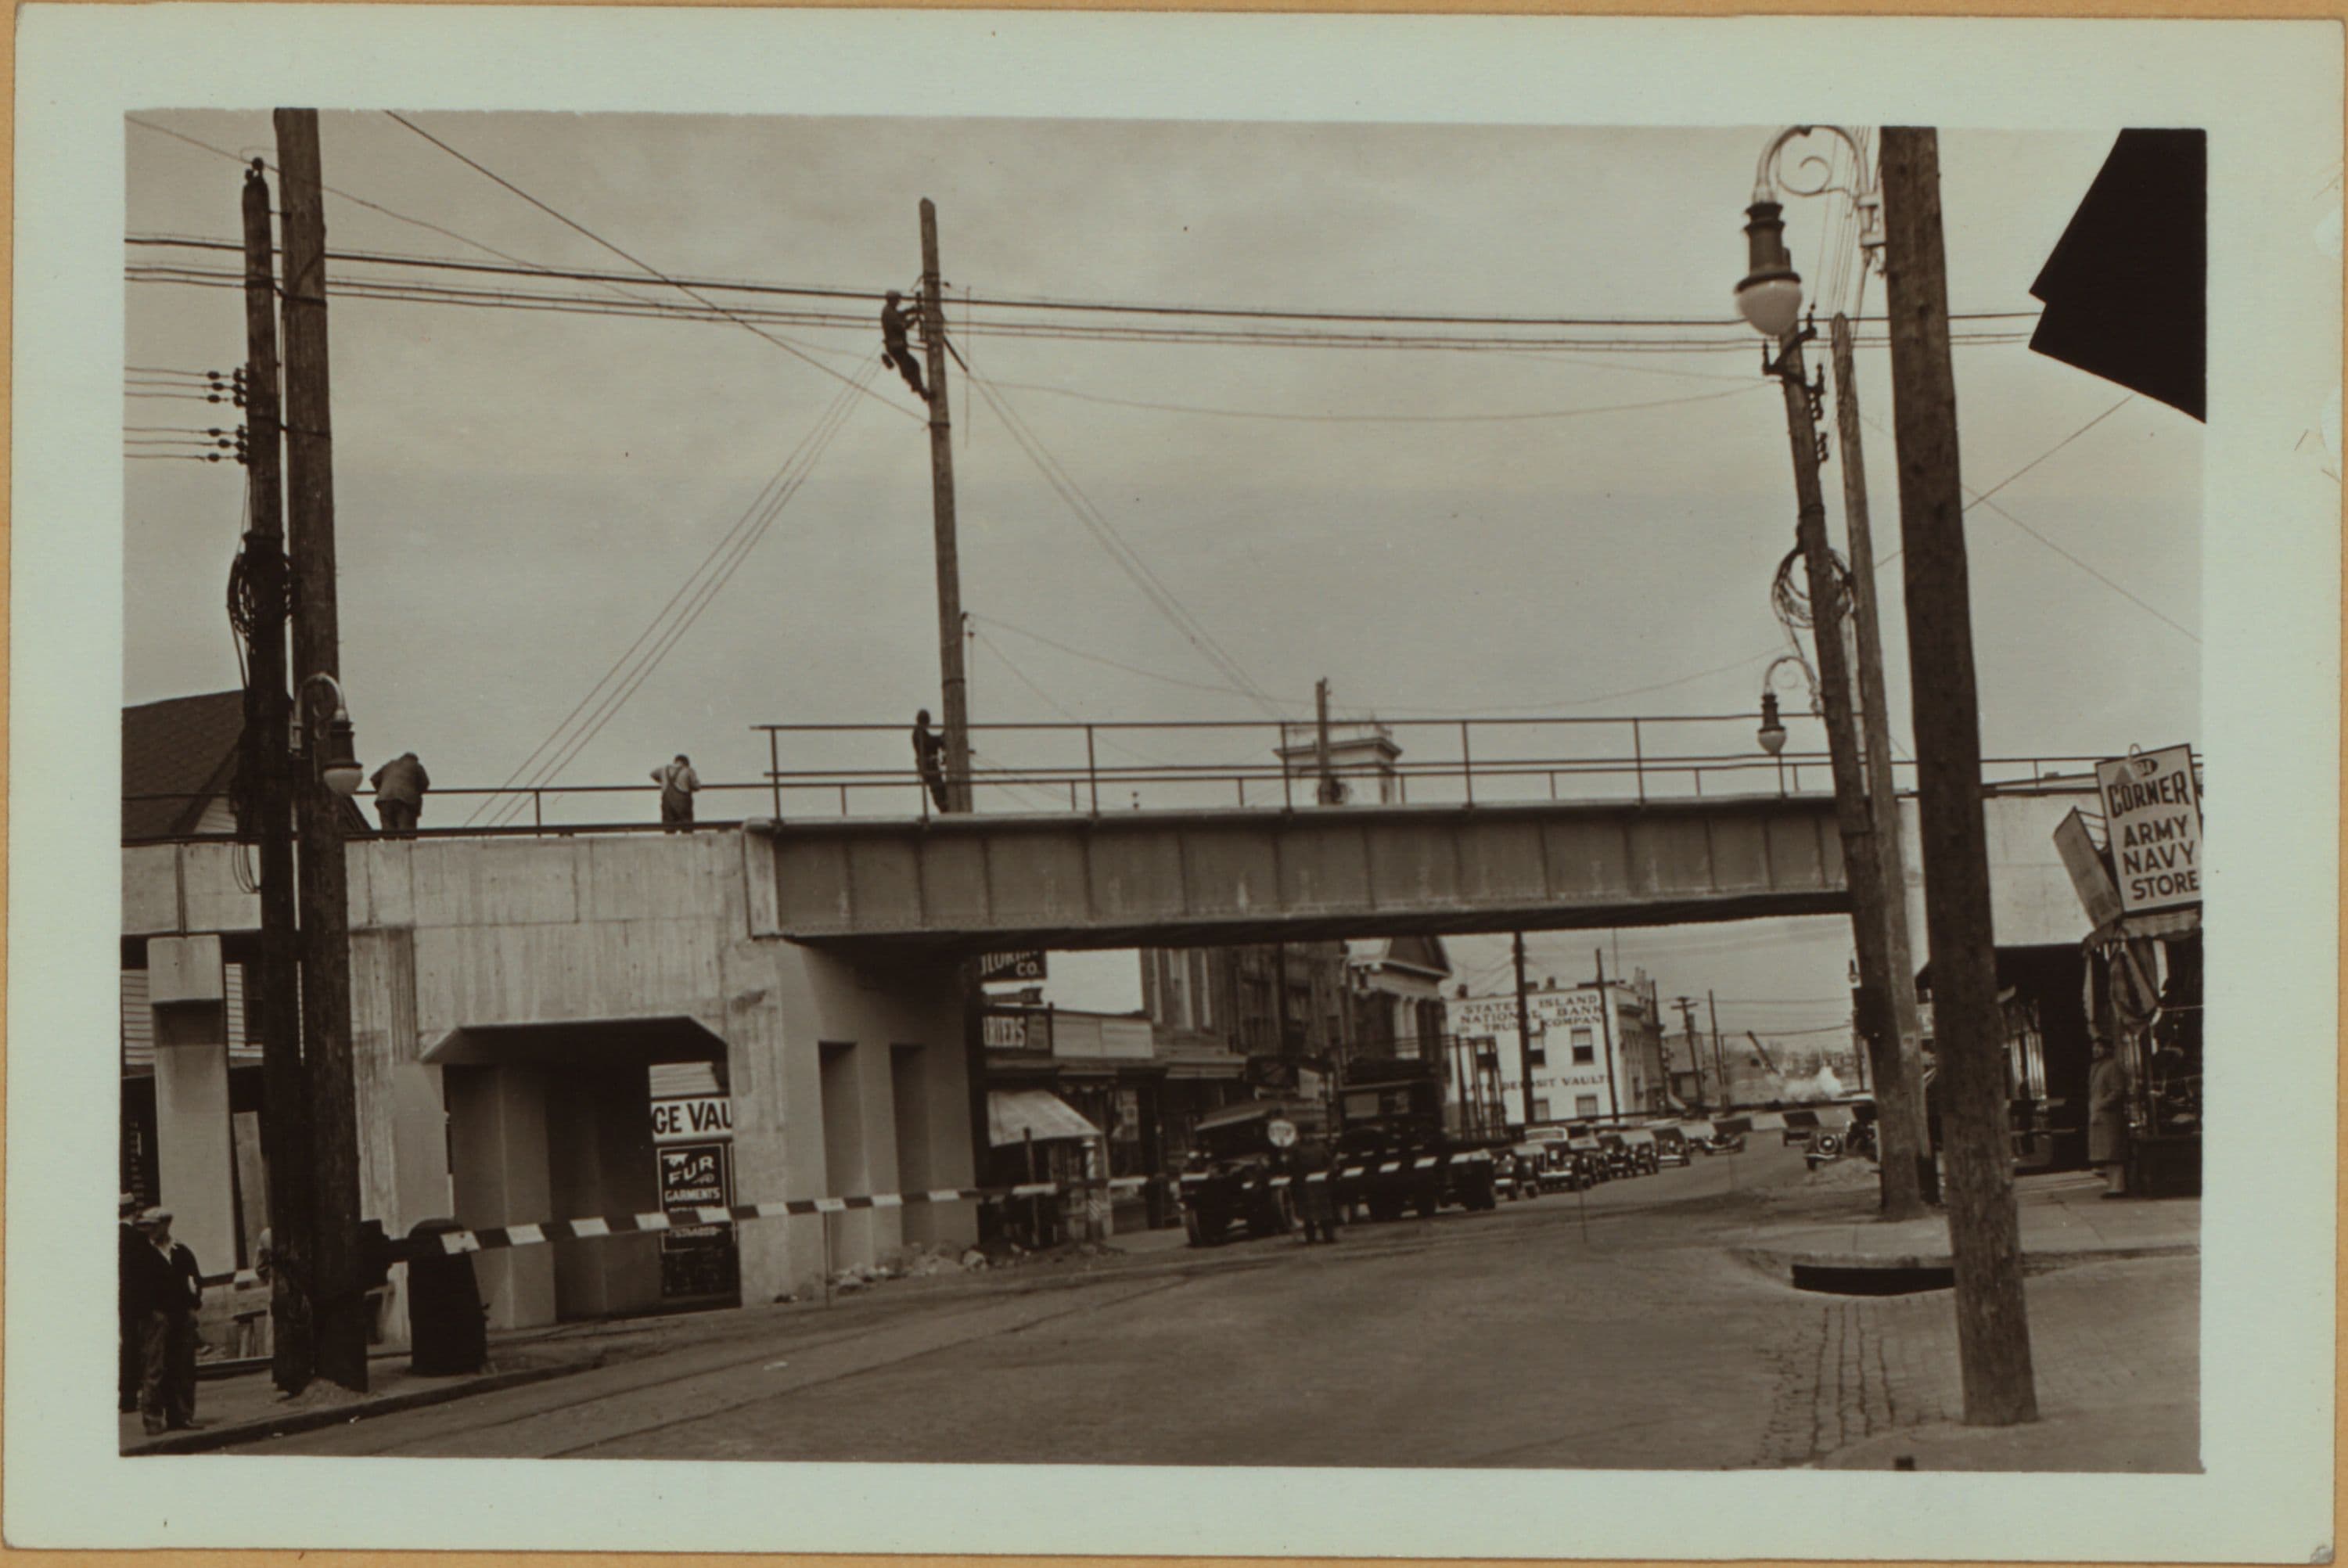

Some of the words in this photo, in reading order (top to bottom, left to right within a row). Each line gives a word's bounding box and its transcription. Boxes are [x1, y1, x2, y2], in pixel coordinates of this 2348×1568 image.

[2105, 771, 2192, 818] CORNER
[2123, 815, 2188, 848] ARMY
[2122, 841, 2195, 876] NAVY
[2131, 870, 2200, 901] STORE
[1460, 1010, 1541, 1023] NATIONL
[1464, 1002, 1518, 1014] STATE
[1538, 994, 1598, 1008] ISLAND
[1483, 1021, 1518, 1032] TRUS
[1545, 1016, 1601, 1027] COMPAN
[668, 1156, 715, 1185] FUR
[664, 1187, 721, 1203] GARMENTS
